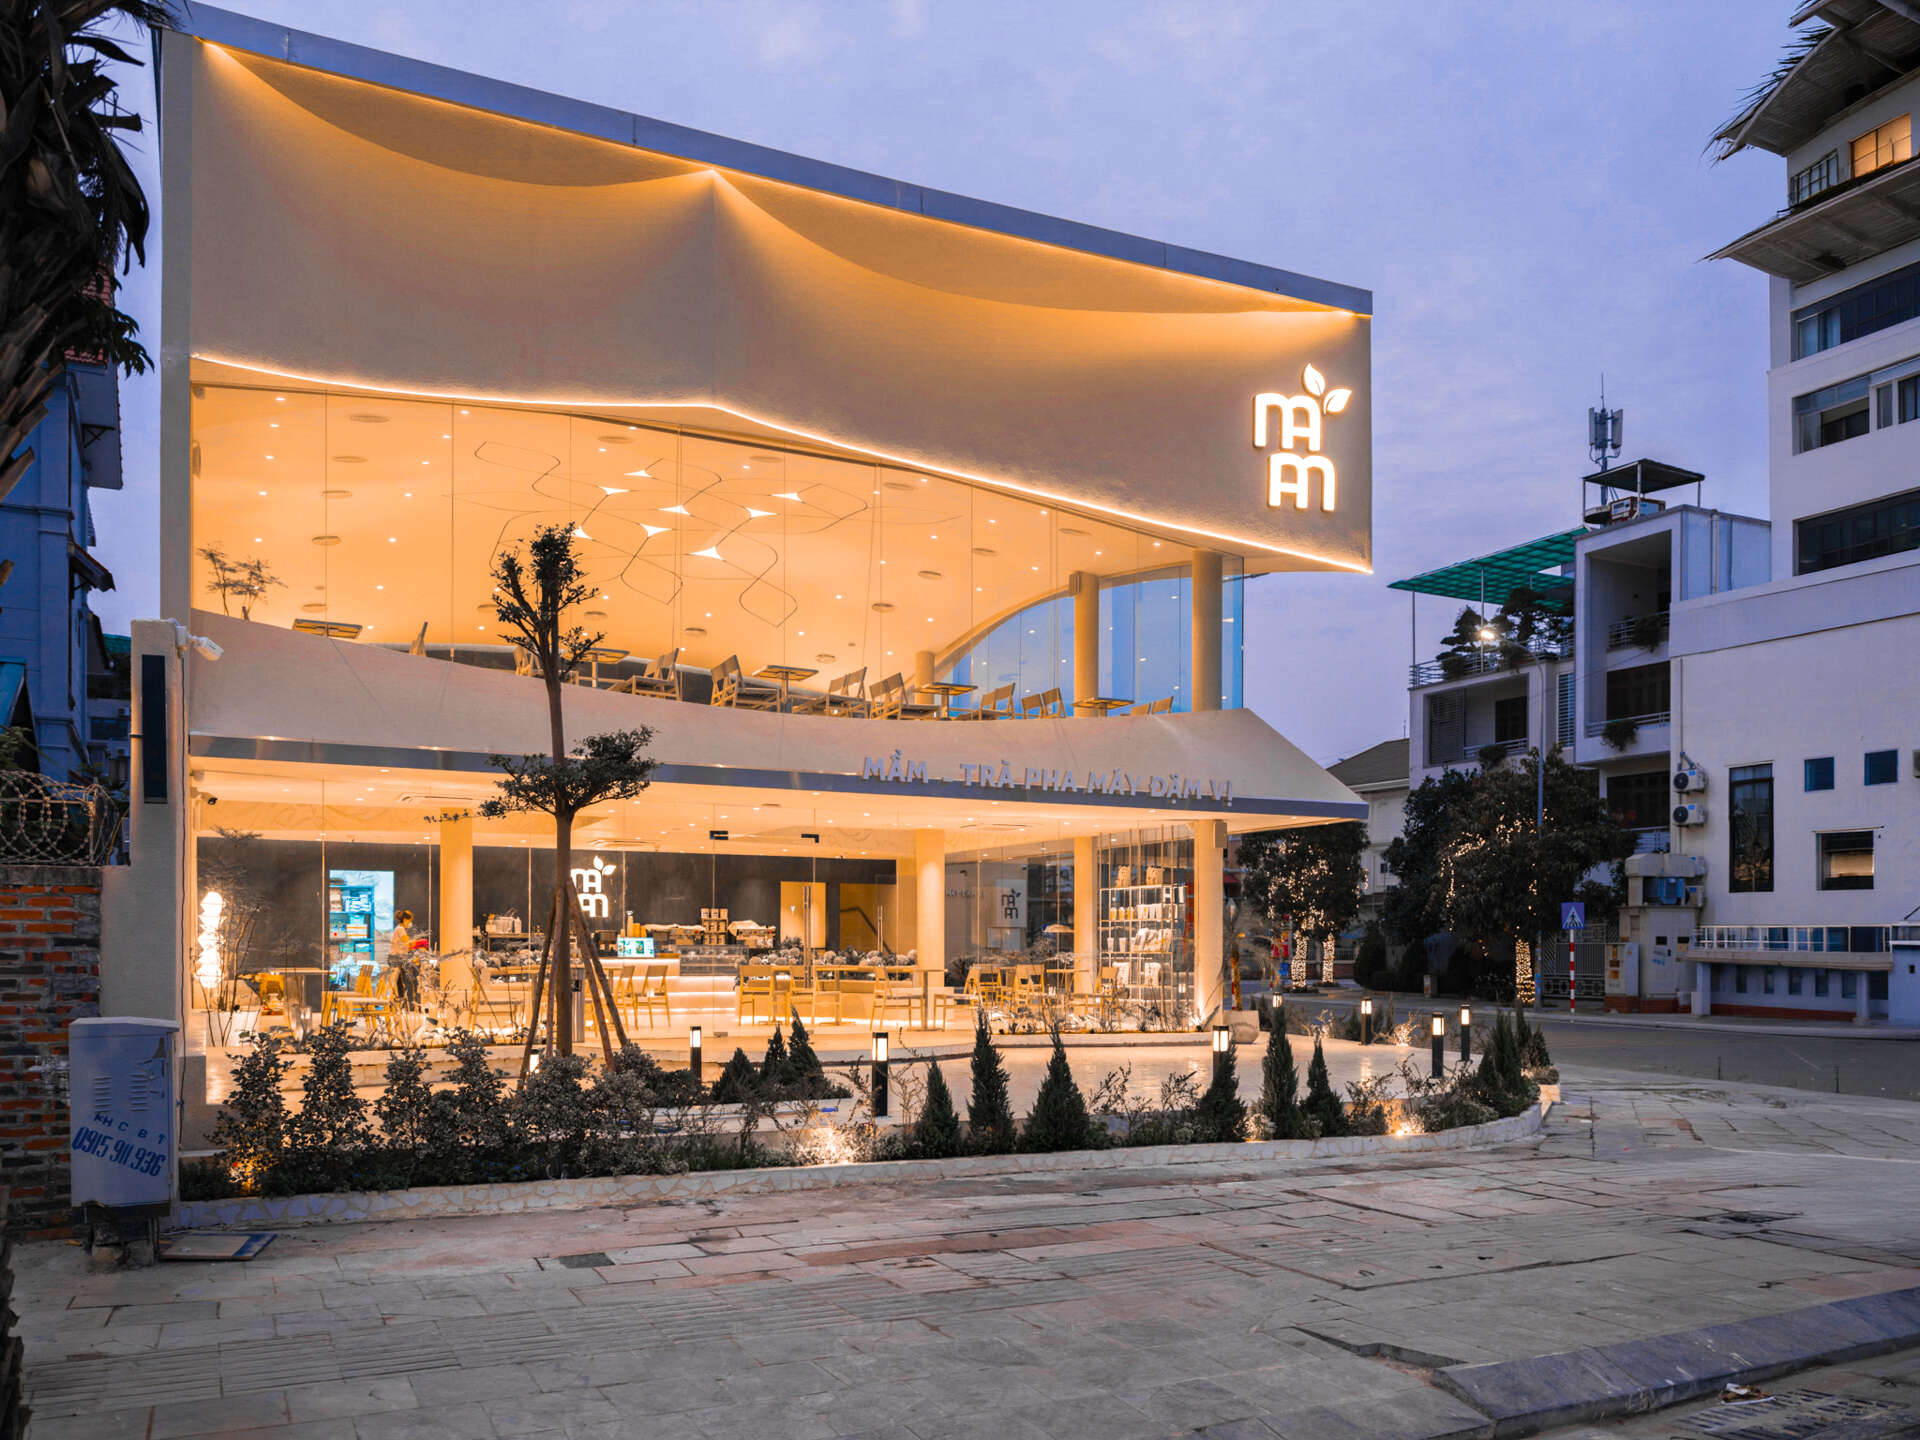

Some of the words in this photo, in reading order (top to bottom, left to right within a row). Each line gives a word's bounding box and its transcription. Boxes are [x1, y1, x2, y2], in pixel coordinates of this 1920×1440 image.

[960, 760, 1015, 789] TRÀ
[1024, 767, 1078, 793] PHA
[1087, 767, 1142, 796] MÁY
[1209, 779, 1233, 807] VỊ
[72, 1126, 114, 1158] 0915
[109, 1139, 134, 1166] 911
[130, 1147, 166, 1177] 936
